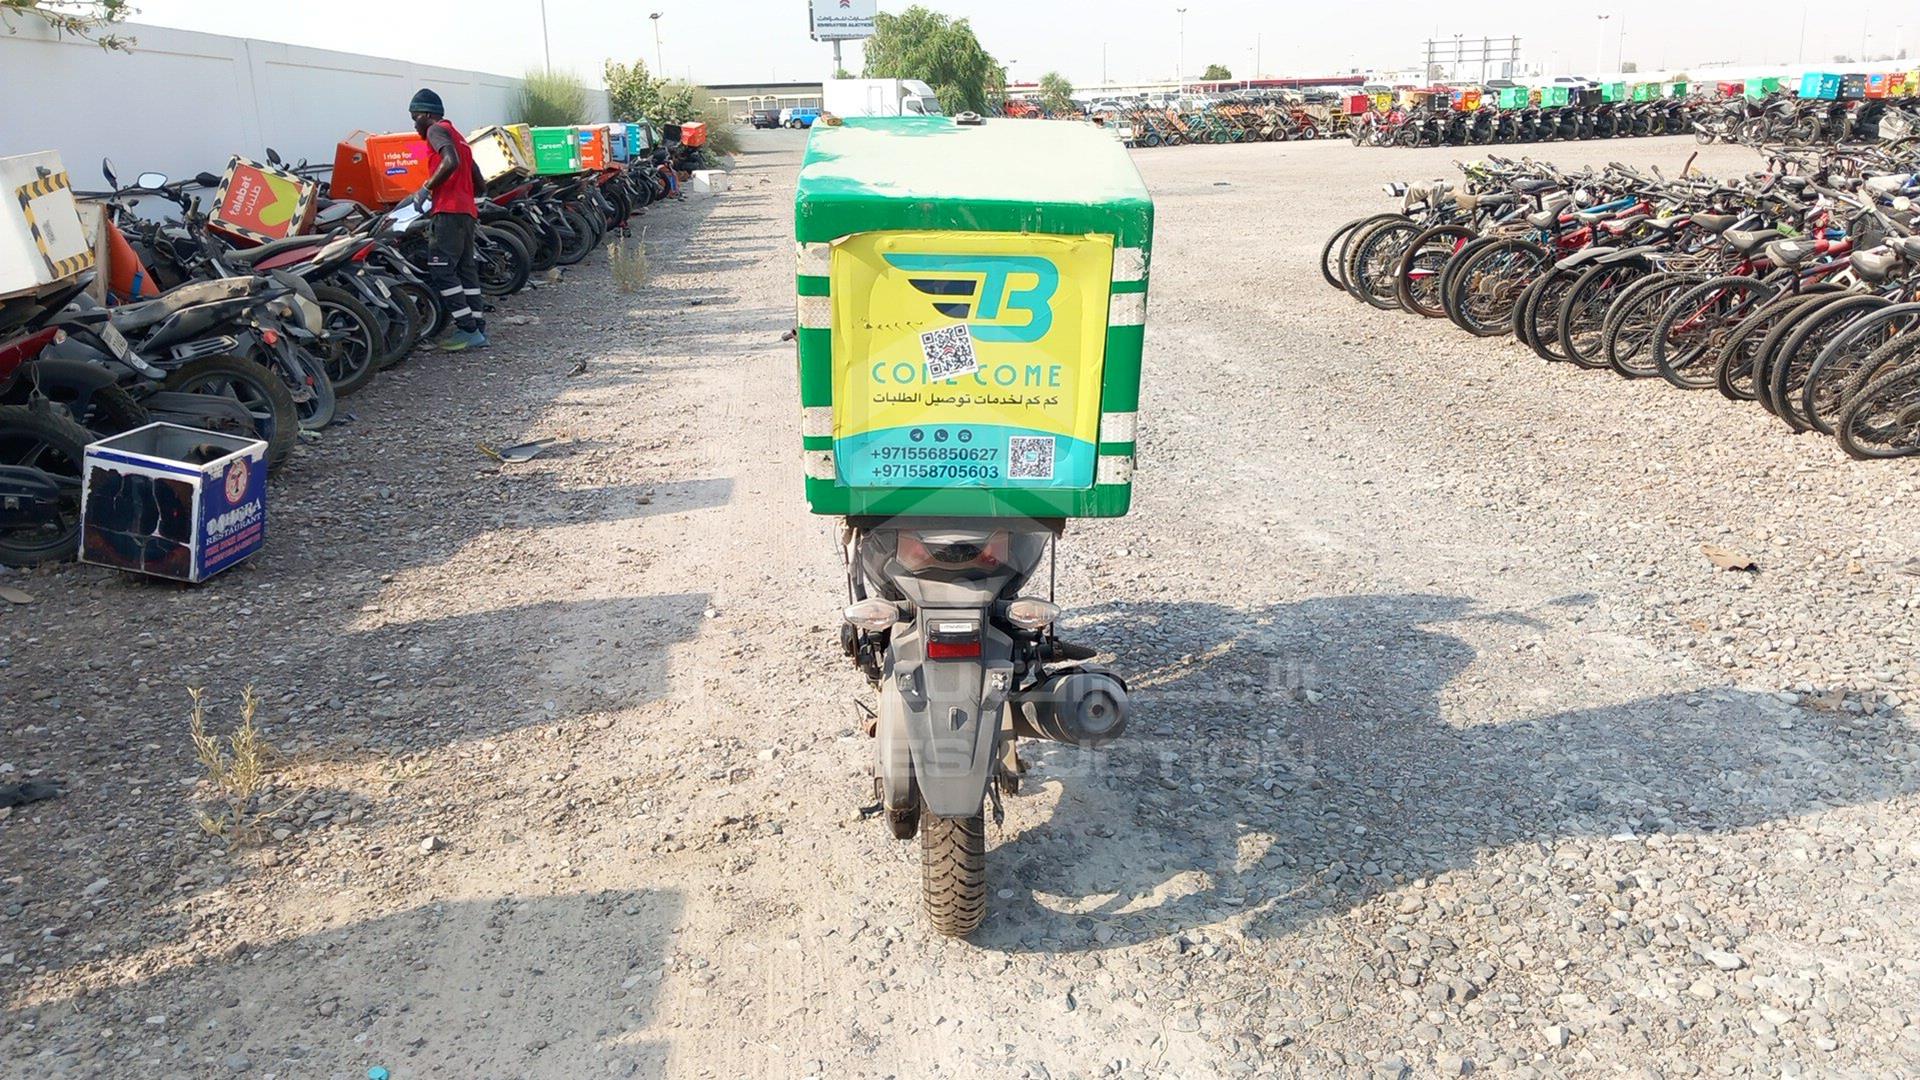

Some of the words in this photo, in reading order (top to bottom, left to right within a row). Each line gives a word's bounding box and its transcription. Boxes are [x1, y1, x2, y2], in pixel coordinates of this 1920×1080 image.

[401, 151, 412, 159] for
[384, 161, 396, 169] my
[228, 175, 253, 216] talabat
[244, 185, 262, 217] طلبات
[973, 364, 1062, 387] COME
[873, 392, 922, 406] الطلبات
[924, 392, 971, 408] توصيل
[974, 393, 1023, 406] لخدمات
[1024, 395, 1041, 410] كم
[1042, 395, 1059, 410] كم
[871, 447, 999, 461] +971556850627
[872, 464, 999, 479] +971558705603
[205, 512, 262, 546] RESTAURANT
